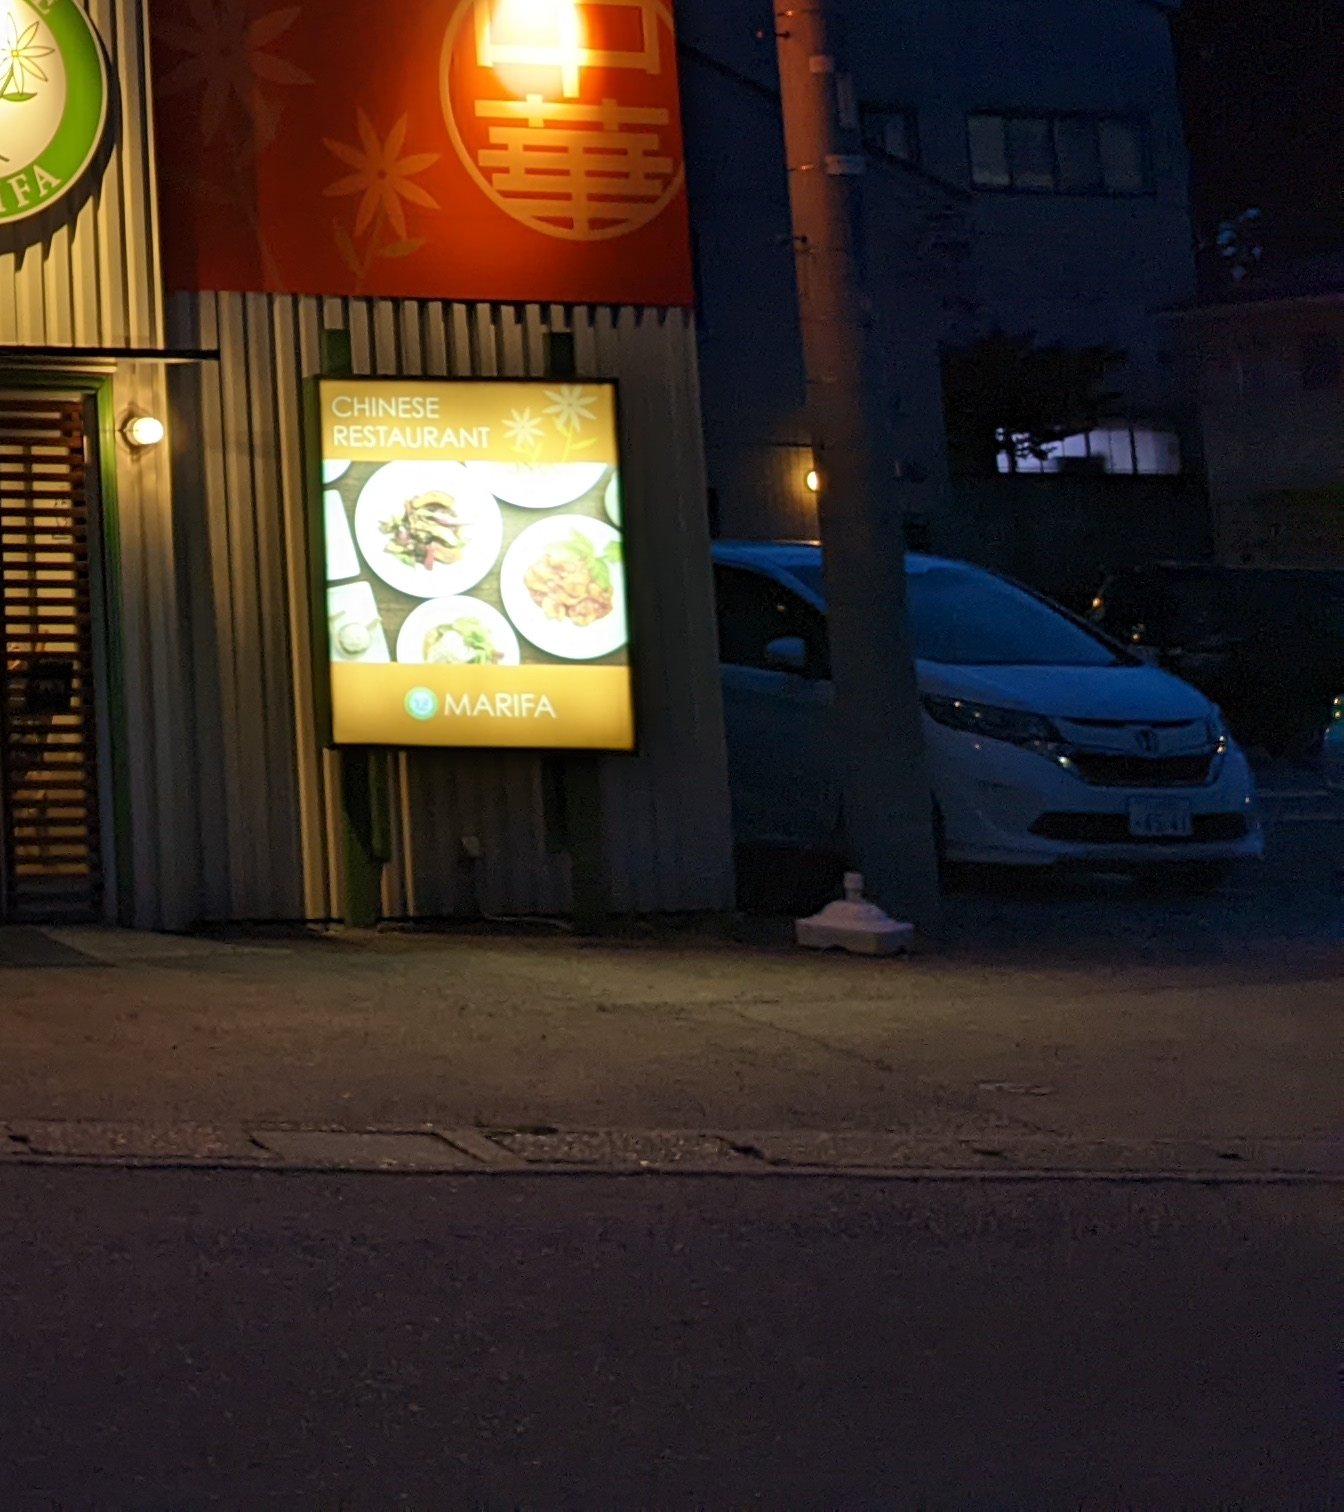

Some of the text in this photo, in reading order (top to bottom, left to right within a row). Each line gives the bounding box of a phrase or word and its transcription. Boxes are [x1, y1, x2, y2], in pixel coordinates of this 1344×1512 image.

[331, 396, 440, 419] CHINESE
[332, 425, 491, 448] RESTAURANT
[444, 692, 557, 719] MARIFA
